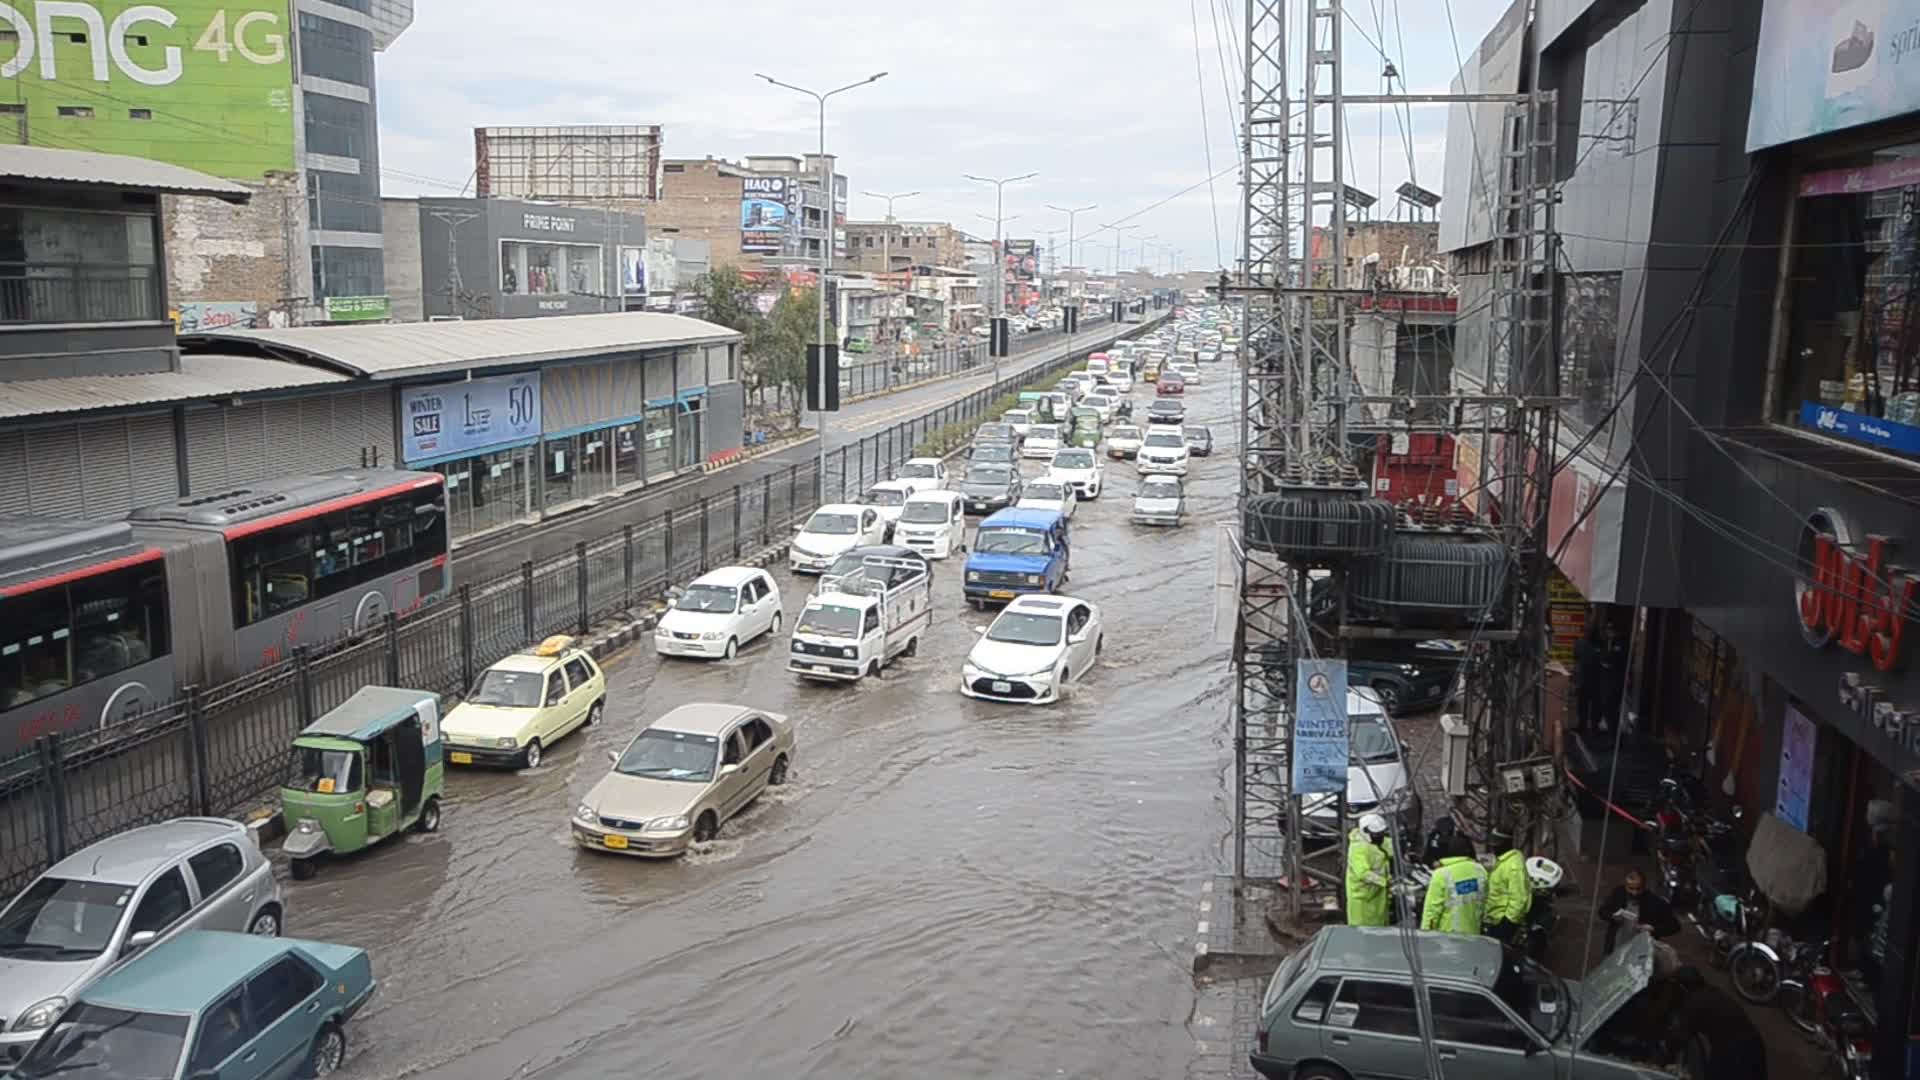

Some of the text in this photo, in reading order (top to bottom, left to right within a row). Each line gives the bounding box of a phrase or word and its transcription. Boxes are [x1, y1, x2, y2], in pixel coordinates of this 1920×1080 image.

[193, 10, 285, 65] 4G
[743, 178, 770, 193] HAQ
[523, 213, 576, 233] PRIME POINT
[409, 396, 443, 413] WINTER
[508, 383, 534, 426] 50
[414, 415, 439, 435] SALE
[1297, 719, 1345, 730] WINTER
[1297, 729, 1345, 738] ARRIVALS
